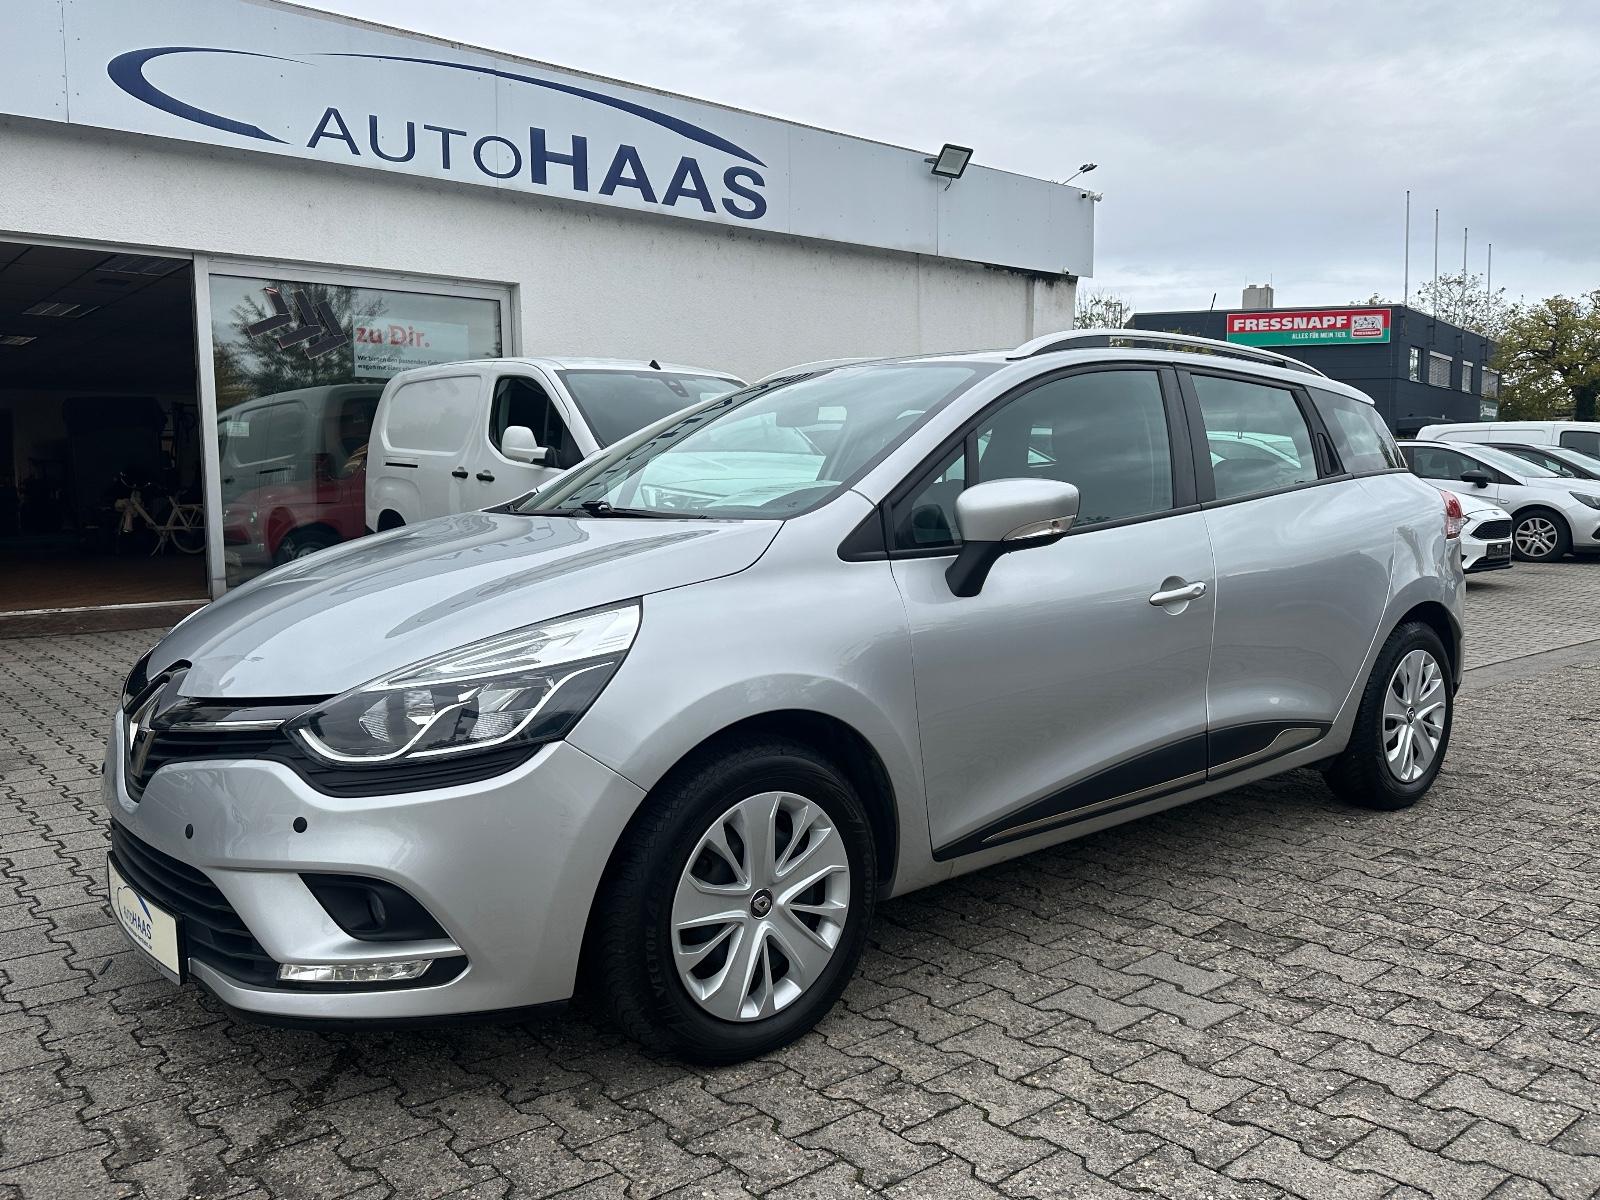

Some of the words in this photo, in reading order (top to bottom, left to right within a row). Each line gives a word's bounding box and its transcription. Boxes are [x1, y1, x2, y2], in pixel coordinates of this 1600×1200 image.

[1233, 315, 1348, 331] FRESSNAPF
[356, 327, 383, 344] zu
[389, 324, 431, 347] Dir.
